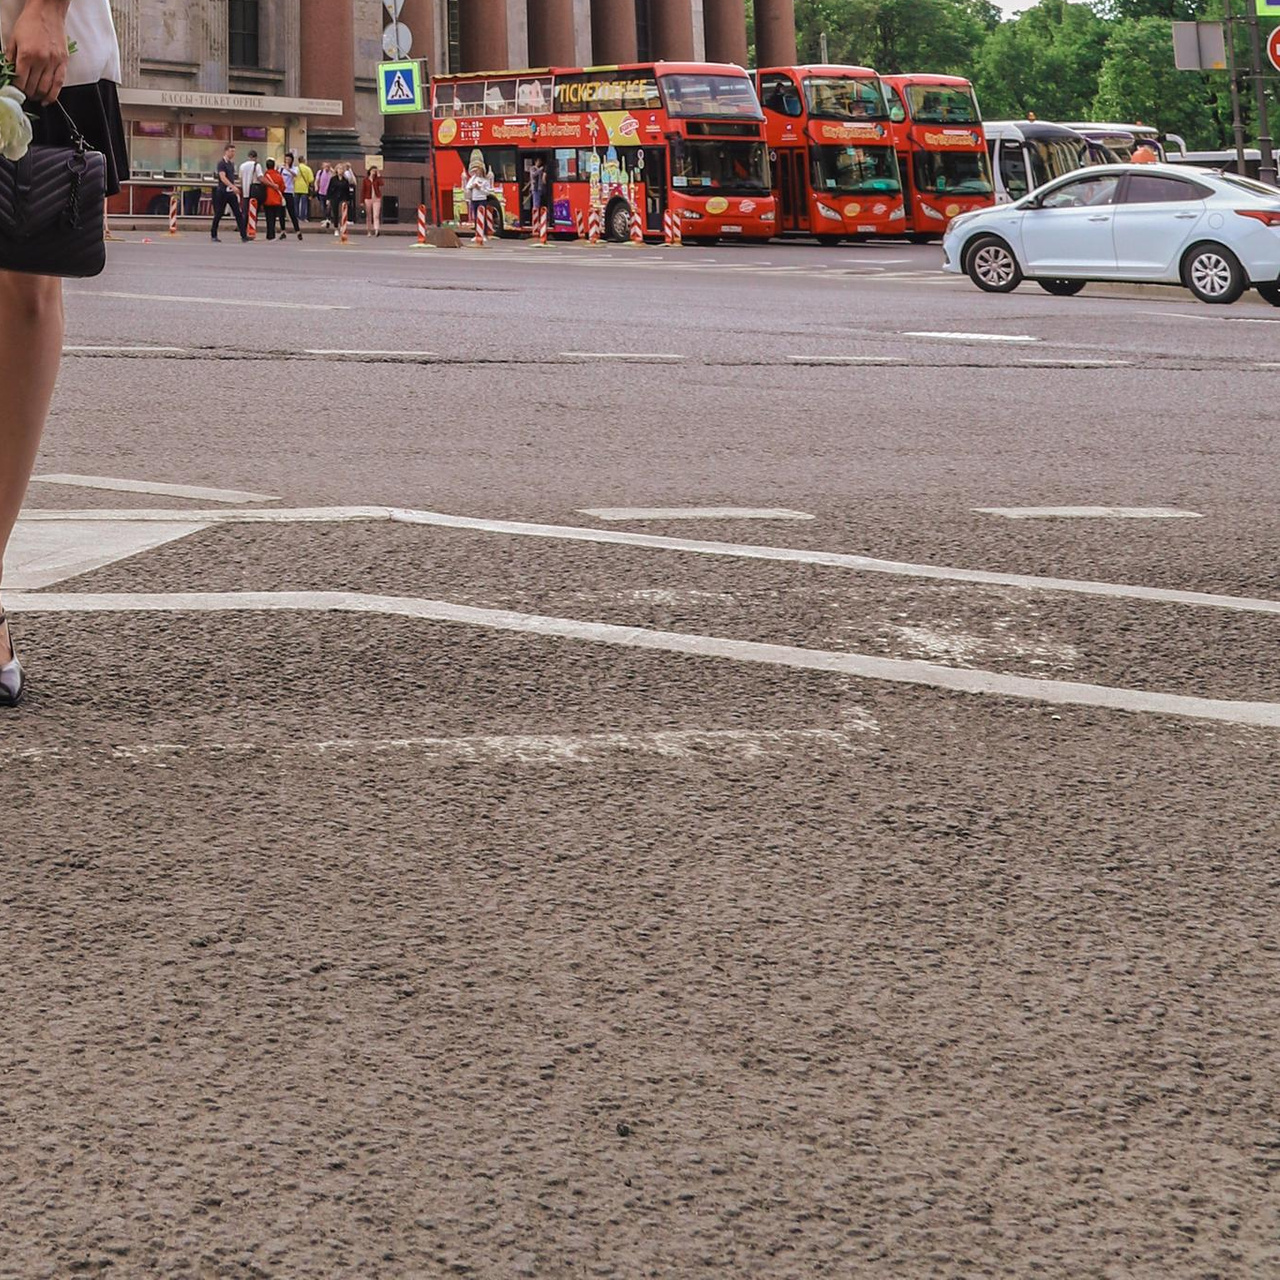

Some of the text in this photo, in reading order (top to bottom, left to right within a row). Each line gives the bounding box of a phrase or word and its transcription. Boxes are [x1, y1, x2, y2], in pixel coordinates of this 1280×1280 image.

[161, 92, 264, 109] КАССЫ TICKET OFFICE
[559, 79, 647, 103] TICKET OFFICE
